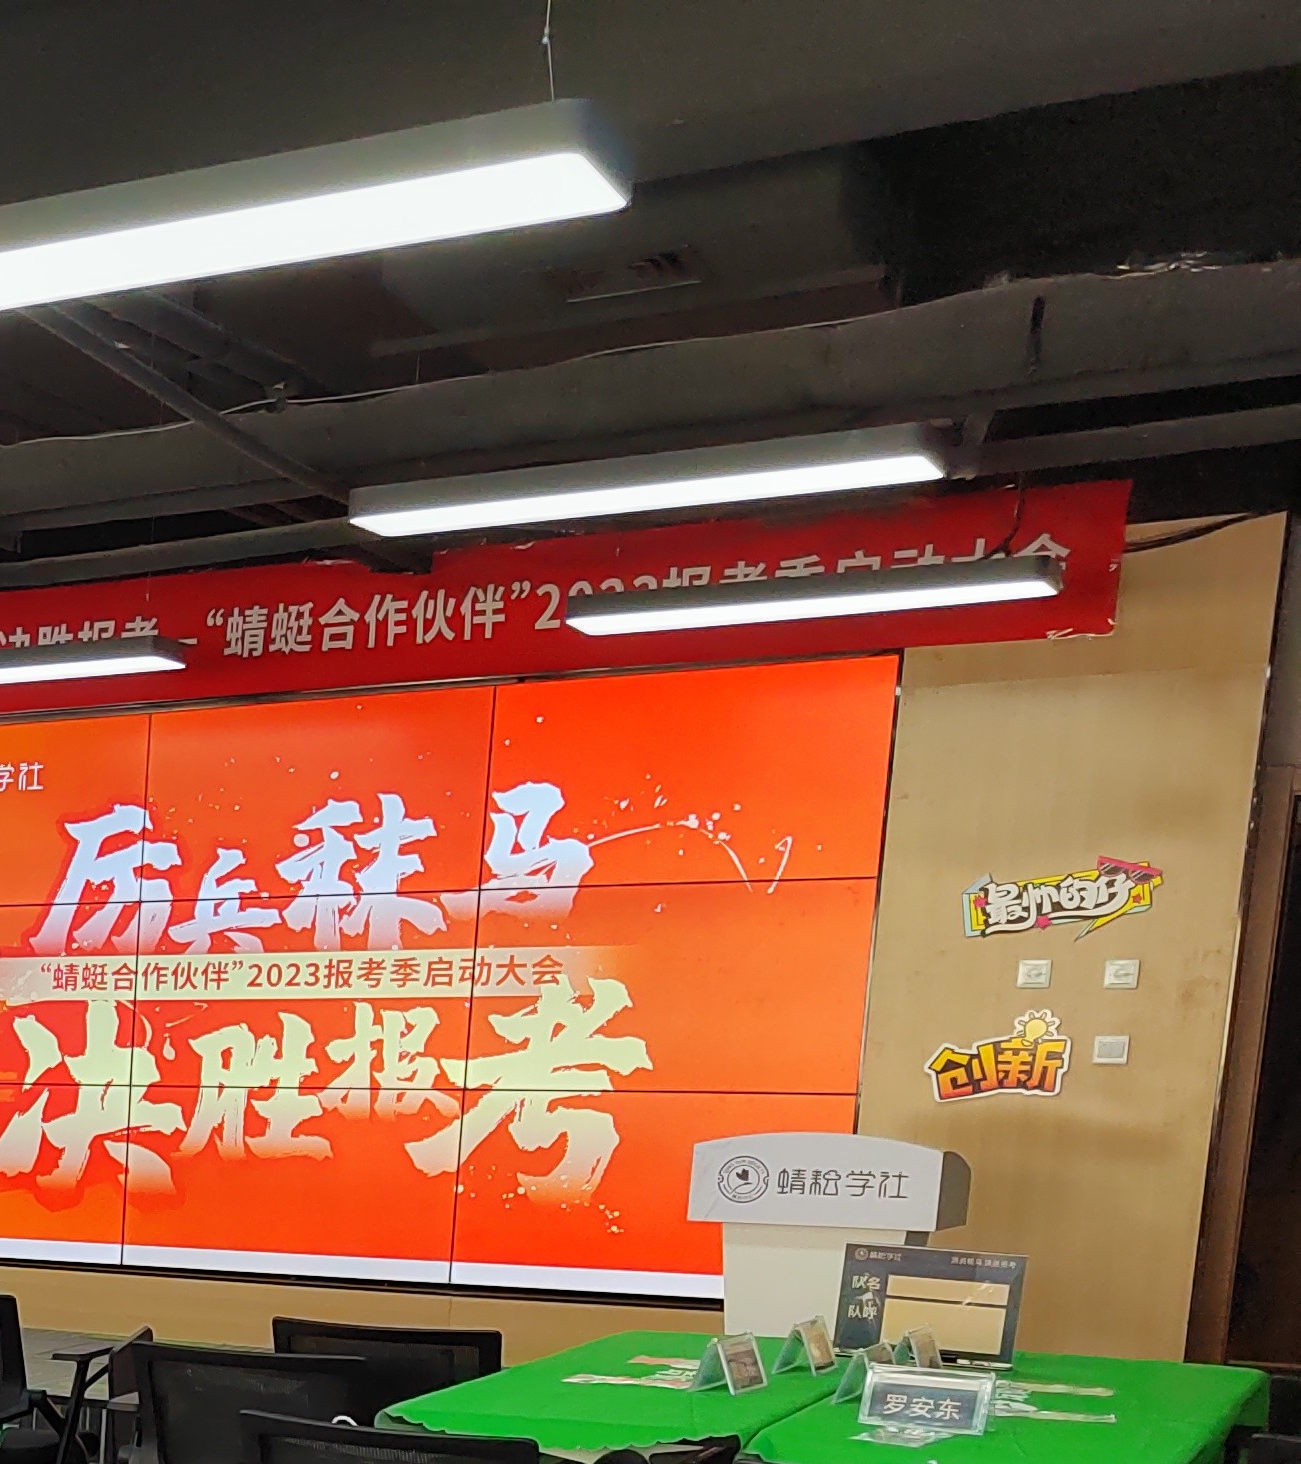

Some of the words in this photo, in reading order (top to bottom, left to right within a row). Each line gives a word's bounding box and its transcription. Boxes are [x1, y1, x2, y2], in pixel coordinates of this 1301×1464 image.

[29, 782, 595, 953] 厉兵秣马
[929, 1037, 1067, 1100] 创新
[882, 1392, 963, 1421] 罗安东
